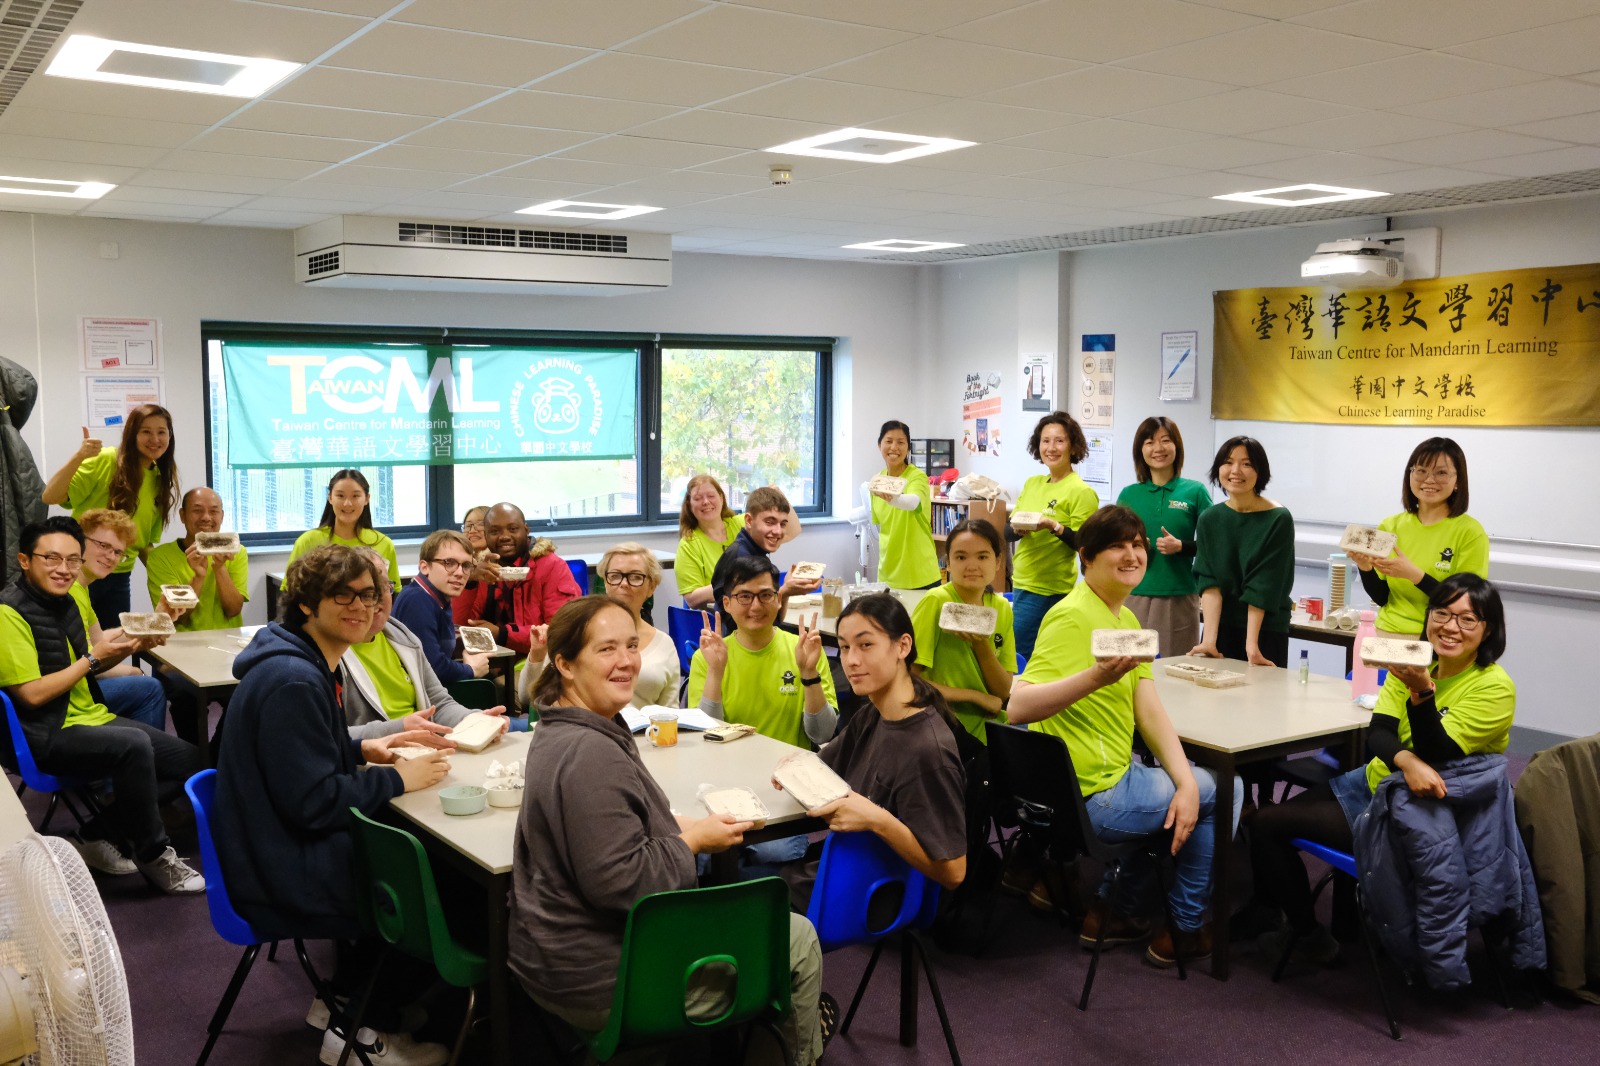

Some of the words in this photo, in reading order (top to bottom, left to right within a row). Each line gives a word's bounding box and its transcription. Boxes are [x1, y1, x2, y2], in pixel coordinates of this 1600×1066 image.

[1289, 347, 1333, 361] Taiwan
[1337, 345, 1381, 360] Centre
[1386, 343, 1406, 359] for
[1410, 341, 1480, 358] Mandarin
[1486, 336, 1558, 357] Learning
[267, 355, 500, 414] TCML
[967, 372, 980, 384] Book
[510, 380, 525, 437] CHINESE
[523, 357, 583, 380] LEARNING
[584, 374, 603, 437] PARADISE
[963, 385, 990, 401] Fortnight
[1338, 405, 1381, 418] Chinese
[1384, 405, 1433, 420] Learning
[1437, 405, 1486, 418] Paradise
[271, 418, 319, 431] Taiwan
[323, 417, 367, 431] Centre
[371, 418, 387, 430] for
[390, 417, 448, 430] Mandarin
[451, 417, 500, 431] Learning
[271, 434, 501, 462] 臺灣華語文學習中心
